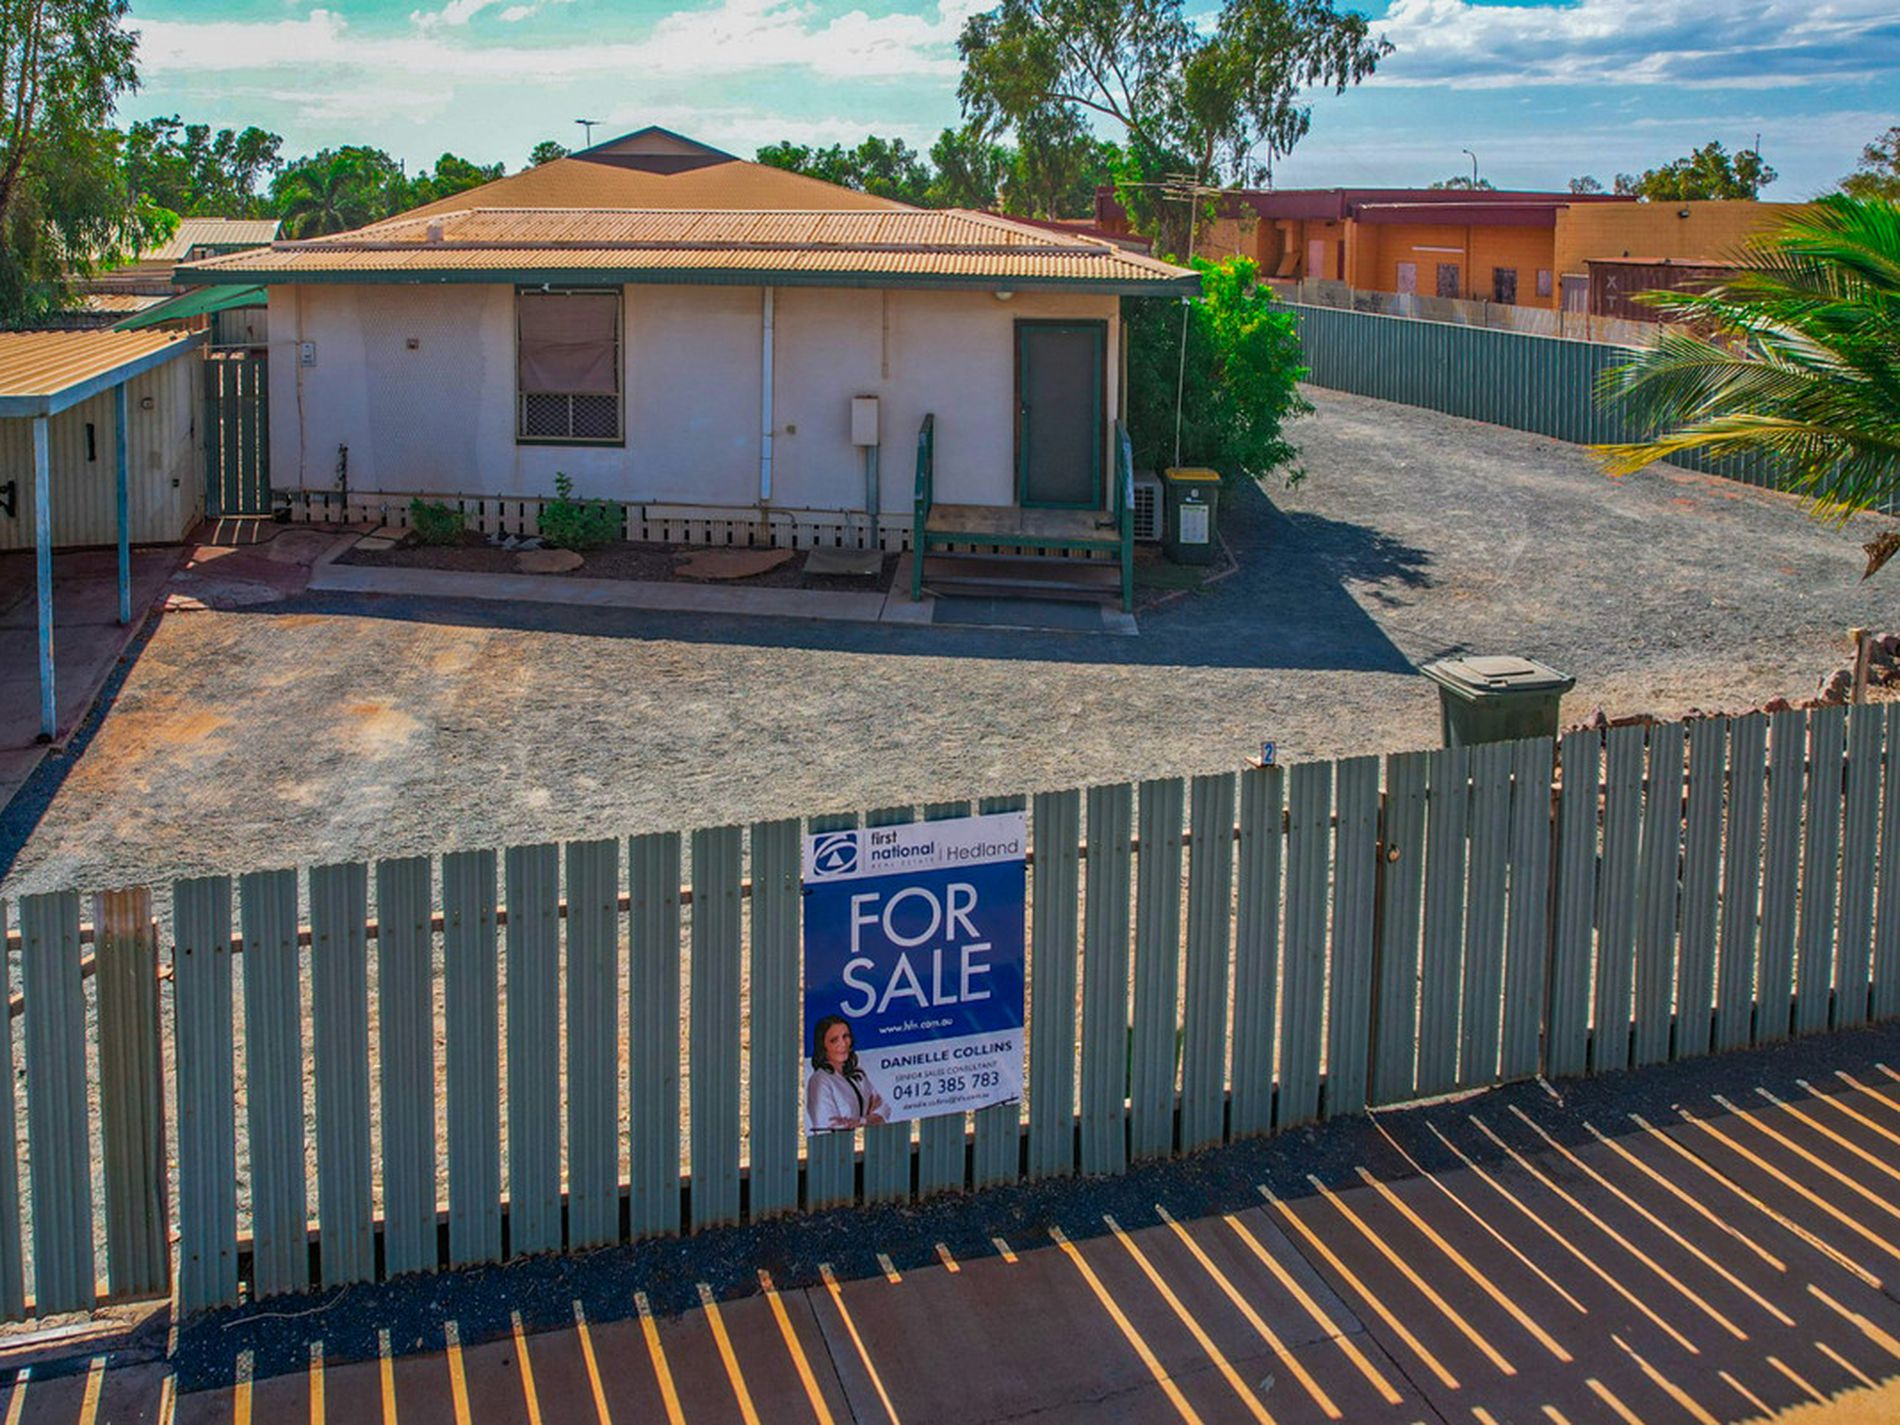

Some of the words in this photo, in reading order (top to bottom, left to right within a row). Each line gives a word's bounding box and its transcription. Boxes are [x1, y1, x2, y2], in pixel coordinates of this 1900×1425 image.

[1263, 742, 1273, 763] 2
[871, 830, 898, 845] first
[871, 841, 935, 861] national
[946, 839, 1019, 862] Hedland
[850, 882, 981, 953] FOR
[839, 942, 992, 1018] SALE
[880, 1049, 950, 1070] DANIELLE
[952, 1040, 1013, 1060] COLLINS
[946, 1060, 998, 1075] CONSULTANT
[892, 1081, 932, 1101] 0412
[937, 1076, 966, 1094] 385
[971, 1070, 1000, 1089] 783
